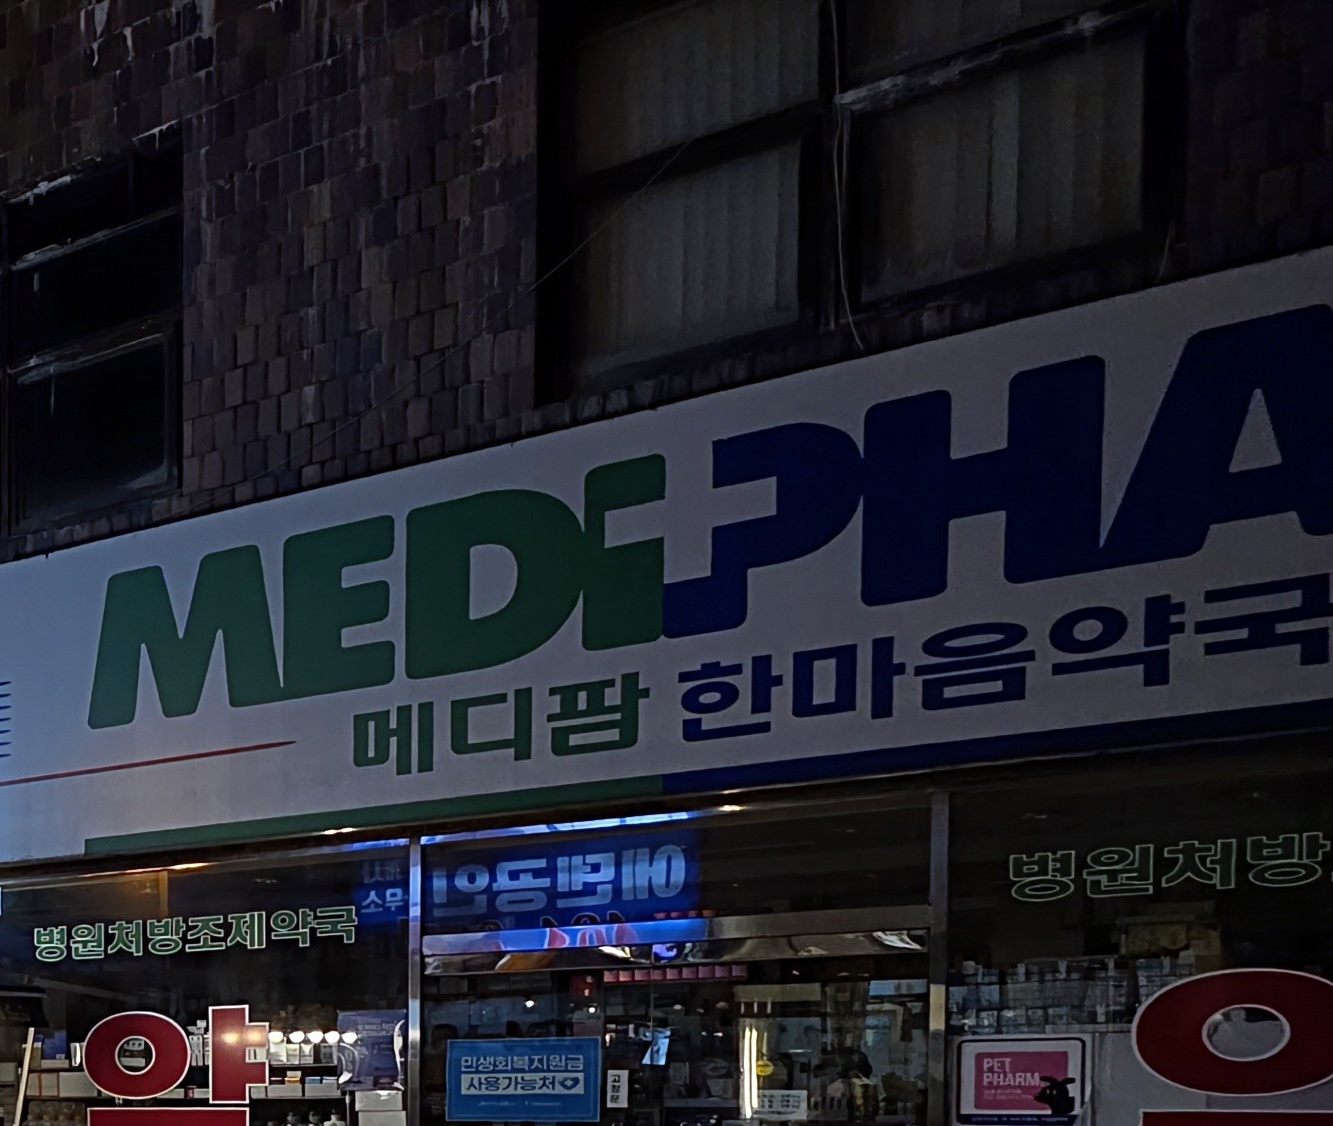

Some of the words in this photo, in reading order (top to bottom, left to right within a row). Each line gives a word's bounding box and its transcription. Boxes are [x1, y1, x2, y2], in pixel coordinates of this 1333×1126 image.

[352, 671, 651, 776] 메디팜
[679, 572, 1333, 743] 한마음약국
[1009, 832, 1333, 902] 병원처방
[34, 905, 359, 963] 병원처방조제약국
[461, 1054, 585, 1073] 민생회복지원금
[983, 1058, 1012, 1073] PET
[466, 1075, 556, 1092] 사용가능처
[983, 1072, 1041, 1087] PHARM
